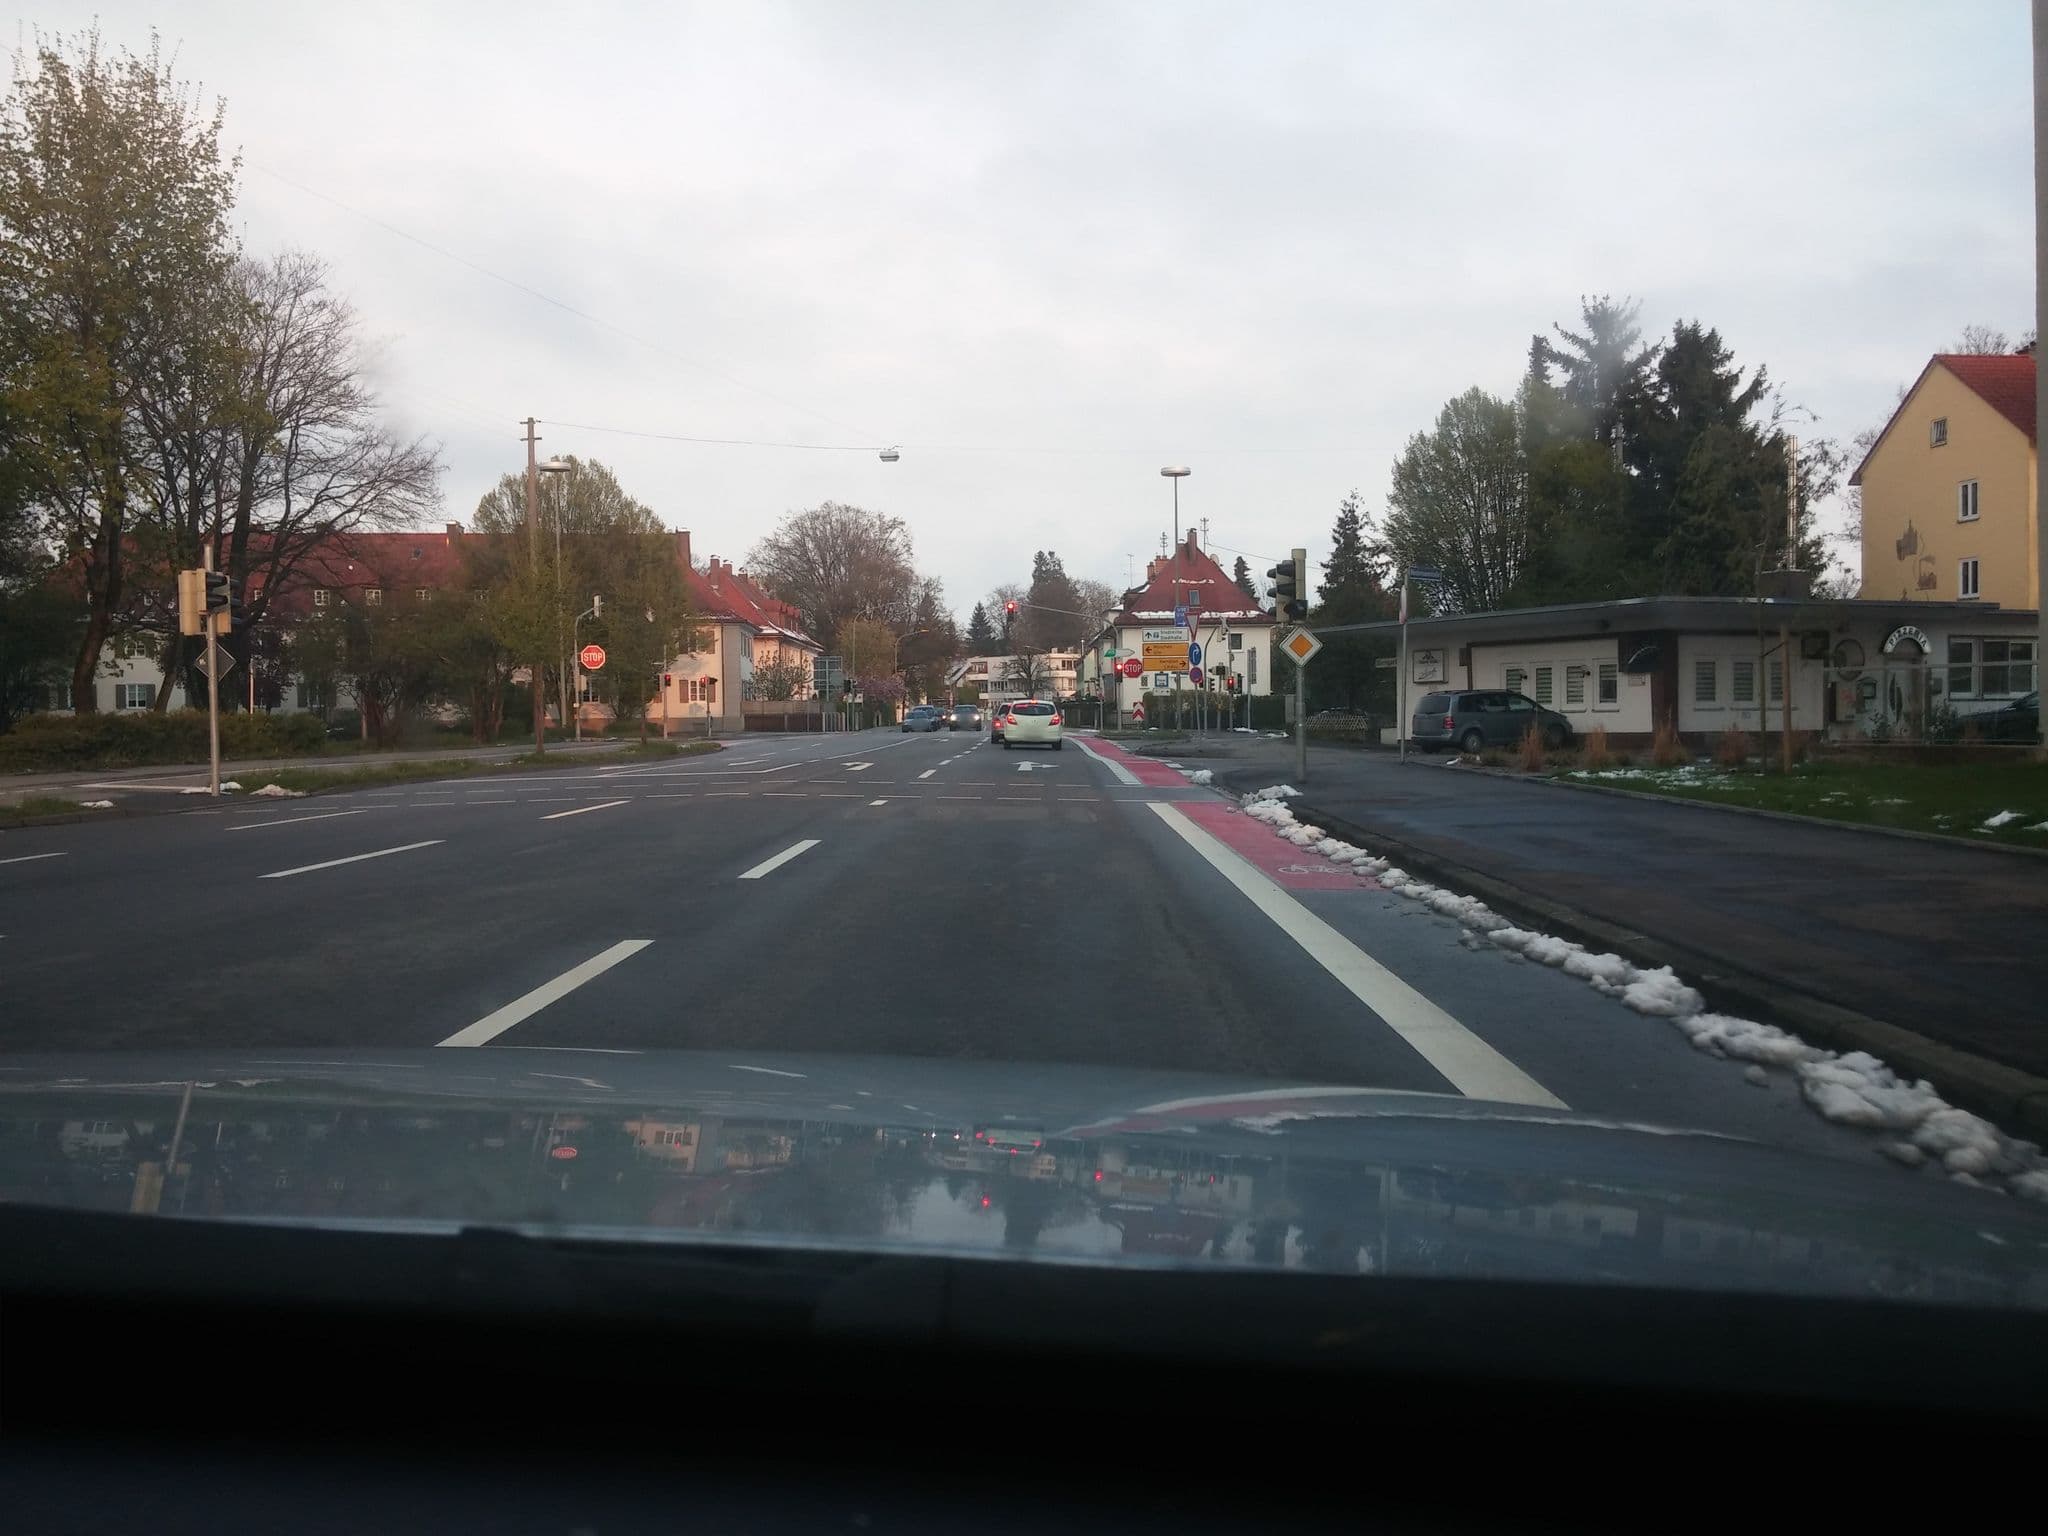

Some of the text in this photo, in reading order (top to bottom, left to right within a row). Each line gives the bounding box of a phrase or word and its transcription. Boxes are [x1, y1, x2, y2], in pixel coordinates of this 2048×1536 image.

[1888, 627, 1928, 648] PIZZERIA
[583, 653, 603, 662] STOP
[1125, 664, 1142, 672] STOP
